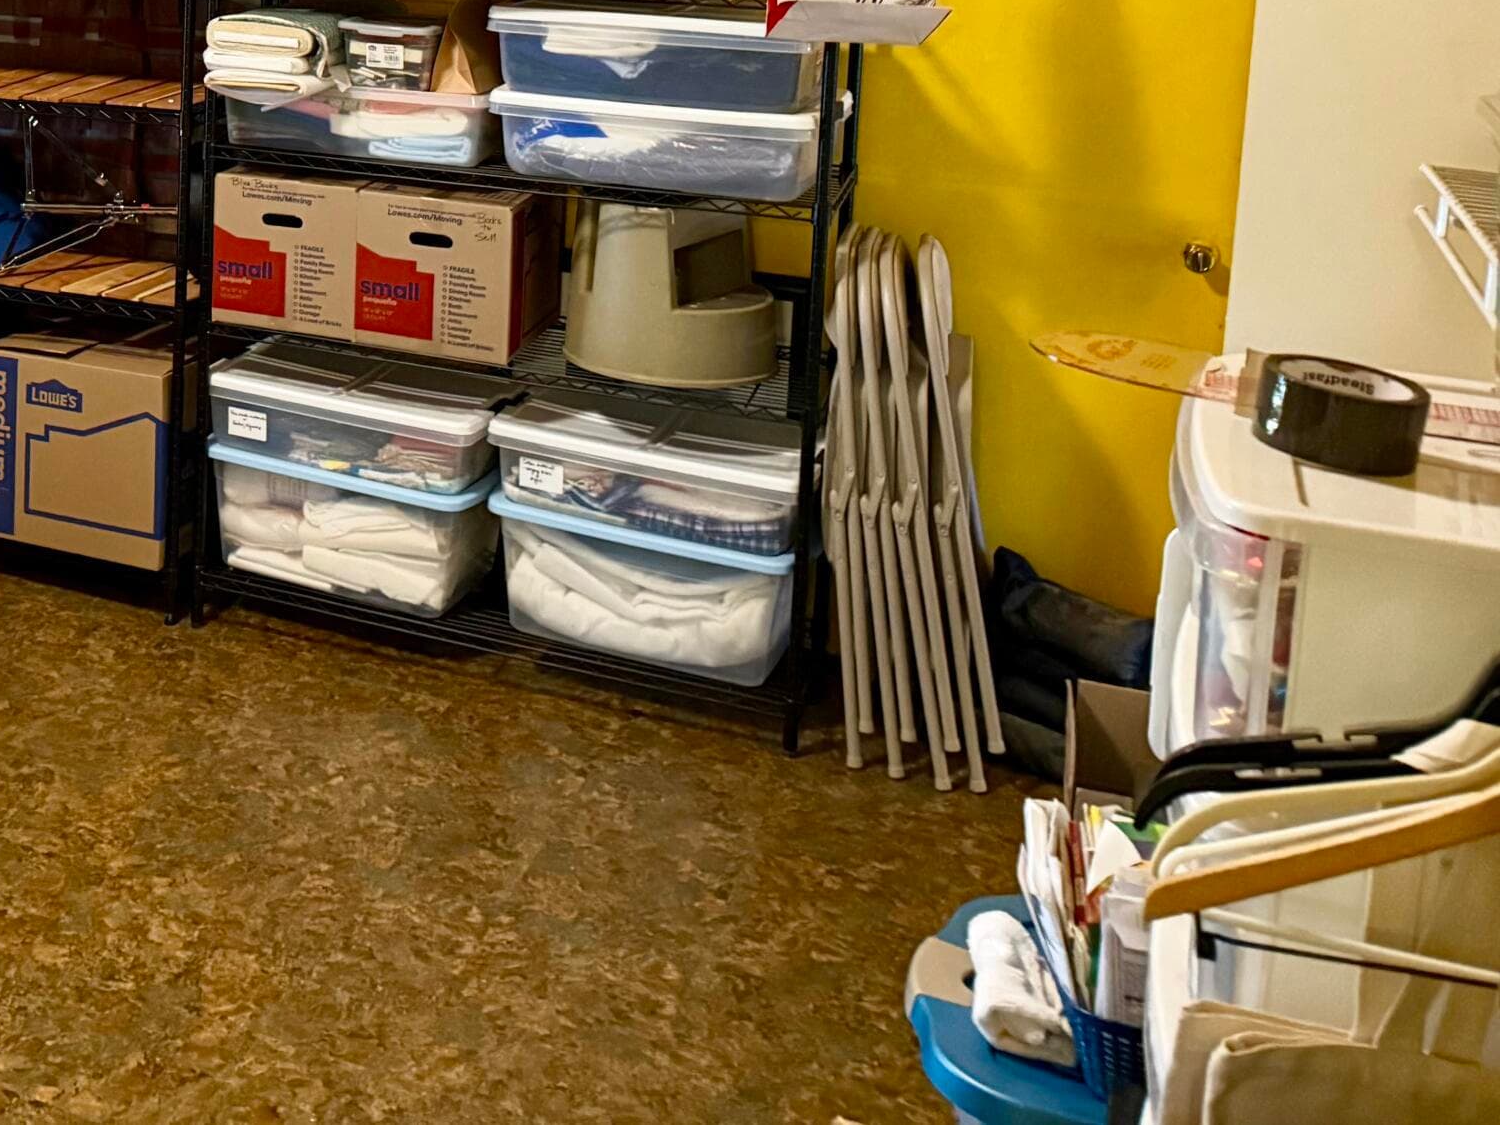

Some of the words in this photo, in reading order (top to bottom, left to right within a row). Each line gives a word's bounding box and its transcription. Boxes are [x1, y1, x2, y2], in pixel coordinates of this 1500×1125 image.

[242, 191, 313, 206] Lowes.com/Moving
[387, 208, 463, 226] Lowes.com/Moving
[218, 261, 272, 280] small
[360, 280, 420, 301] small
[1303, 372, 1376, 396] Steadfast
[31, 387, 77, 409] LOWE'S
